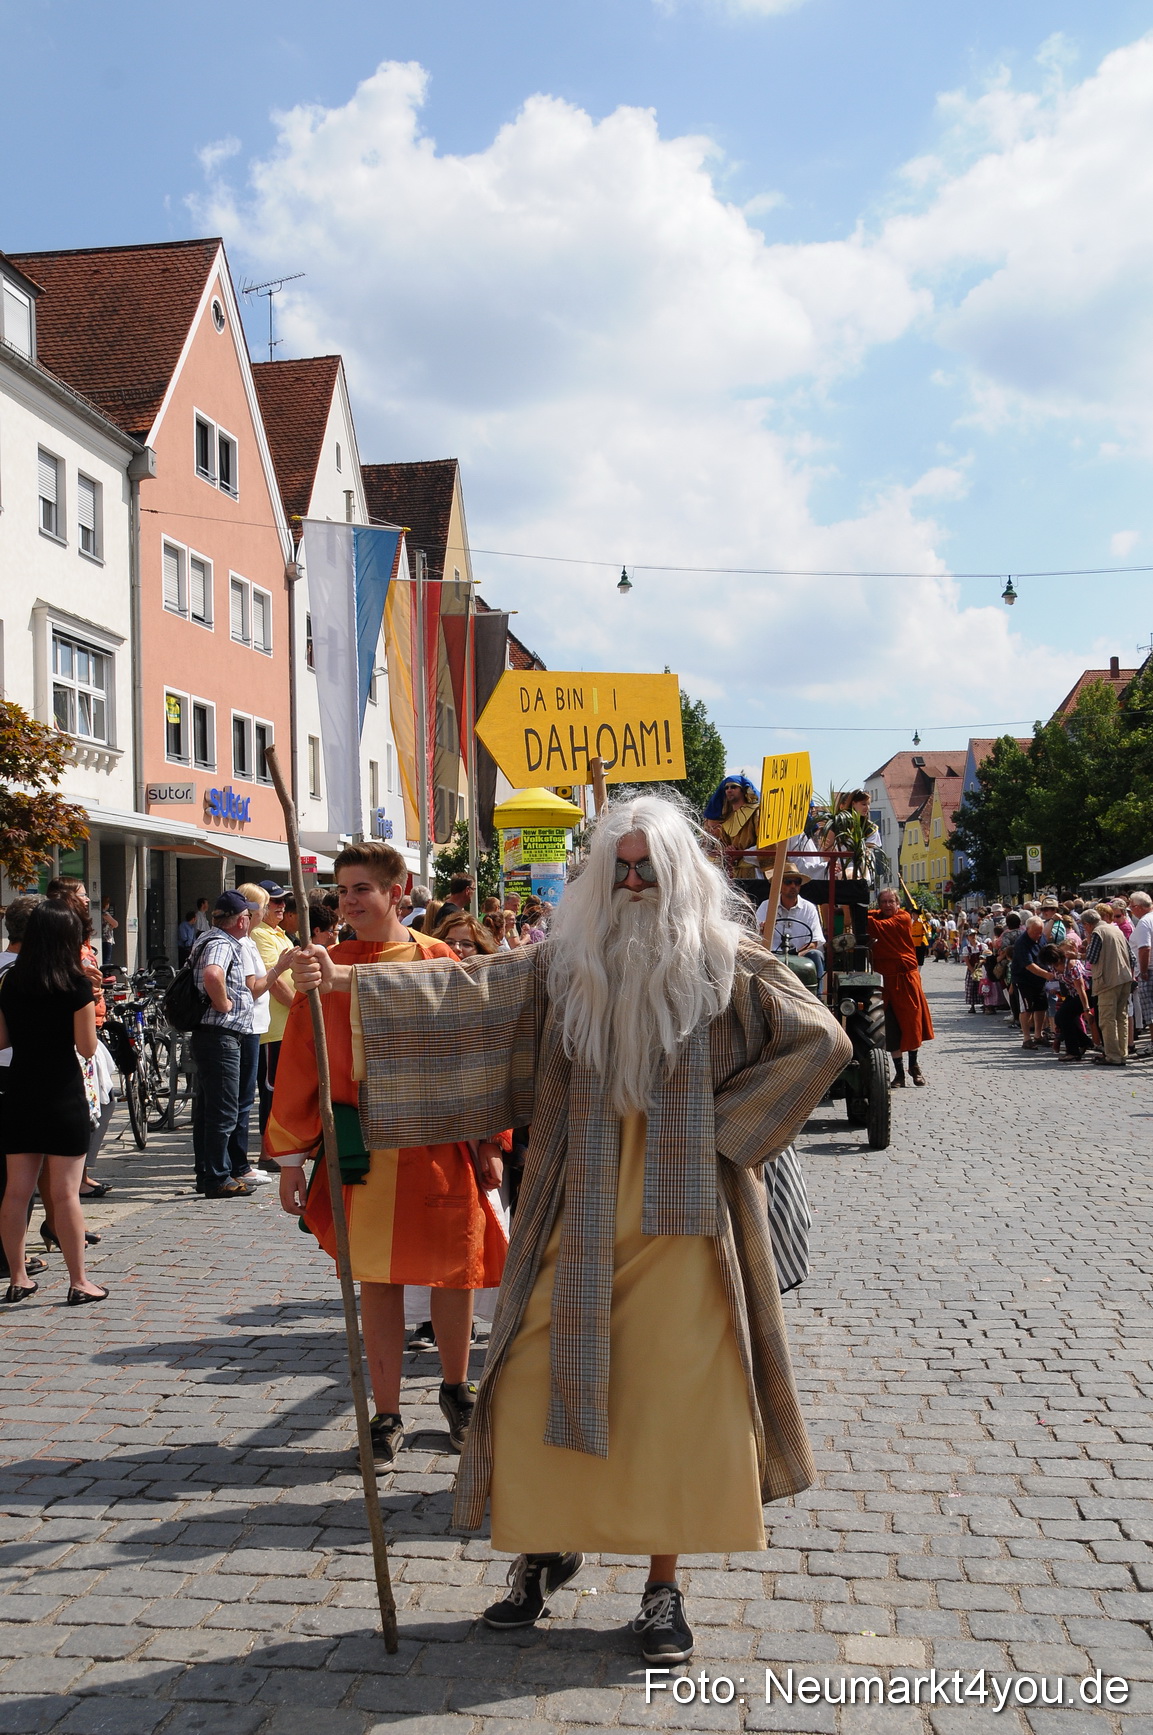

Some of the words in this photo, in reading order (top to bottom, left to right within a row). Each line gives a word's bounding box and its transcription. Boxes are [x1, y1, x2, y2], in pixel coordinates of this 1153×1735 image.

[519, 686, 547, 713] DA
[555, 687, 584, 711] BIN
[612, 687, 617, 711] I
[524, 719, 673, 772] DAHOAM!
[148, 786, 192, 800] sutor.
